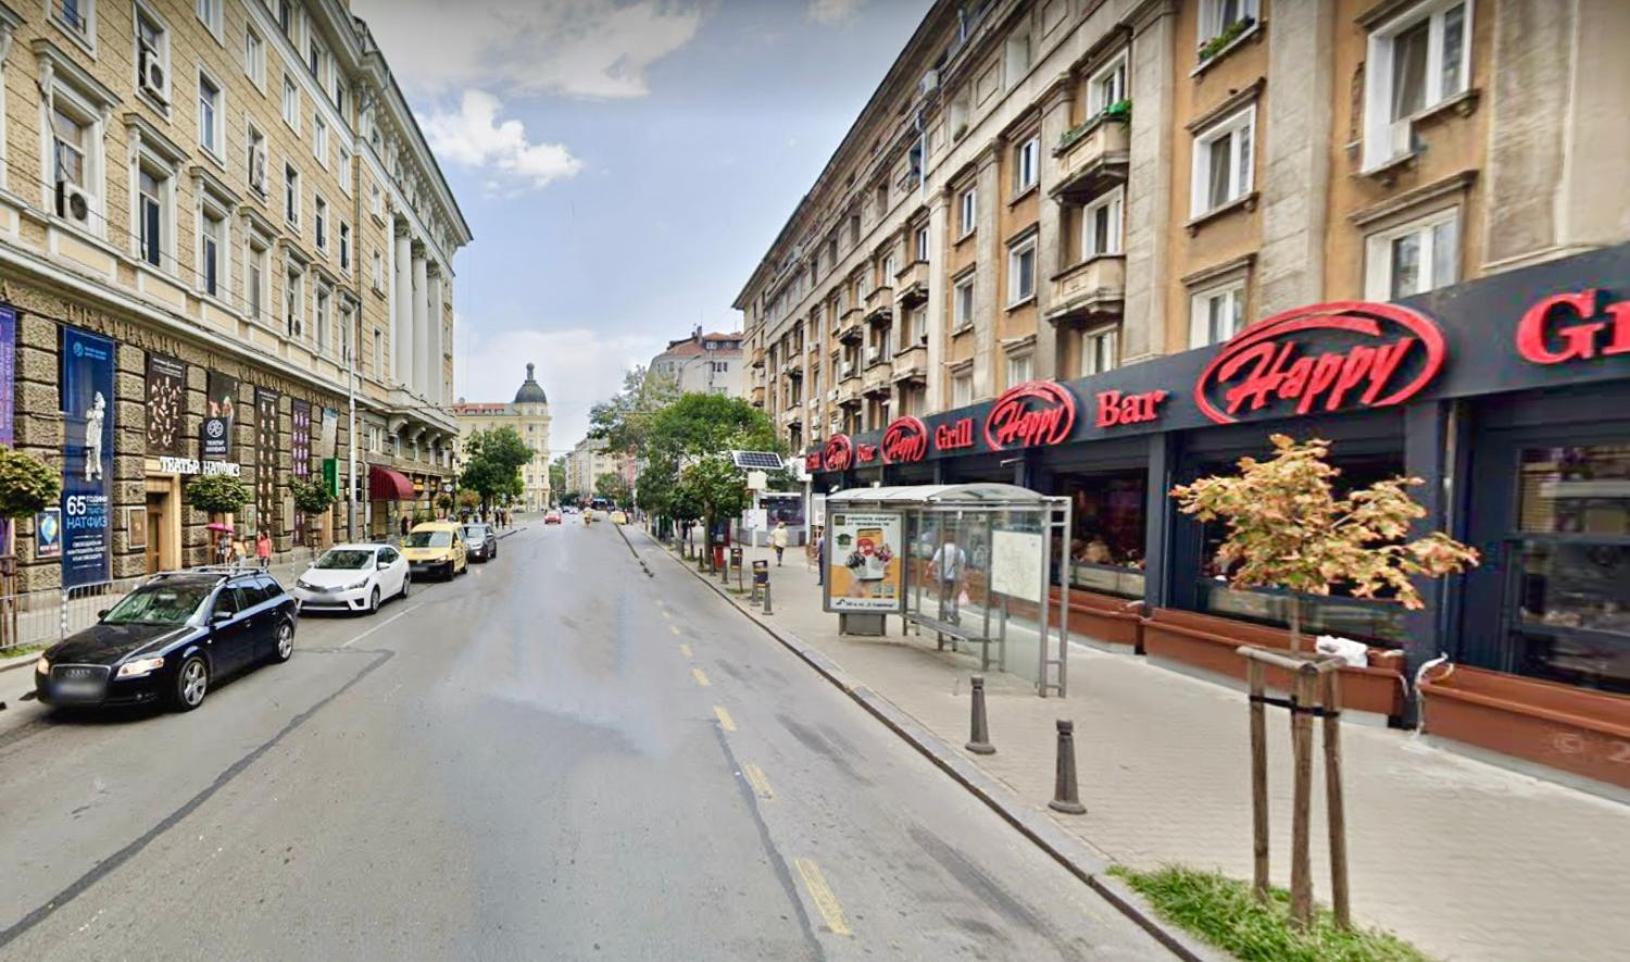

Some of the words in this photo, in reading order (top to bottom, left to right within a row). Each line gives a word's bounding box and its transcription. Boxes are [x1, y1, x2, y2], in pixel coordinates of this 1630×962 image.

[935, 418, 973, 450] Grill
[994, 401, 1065, 448] Happy
[1097, 390, 1168, 428] Bar
[1217, 337, 1414, 415] Happy
[66, 495, 86, 515] 65
[66, 515, 108, 529] НАТФИЗ
